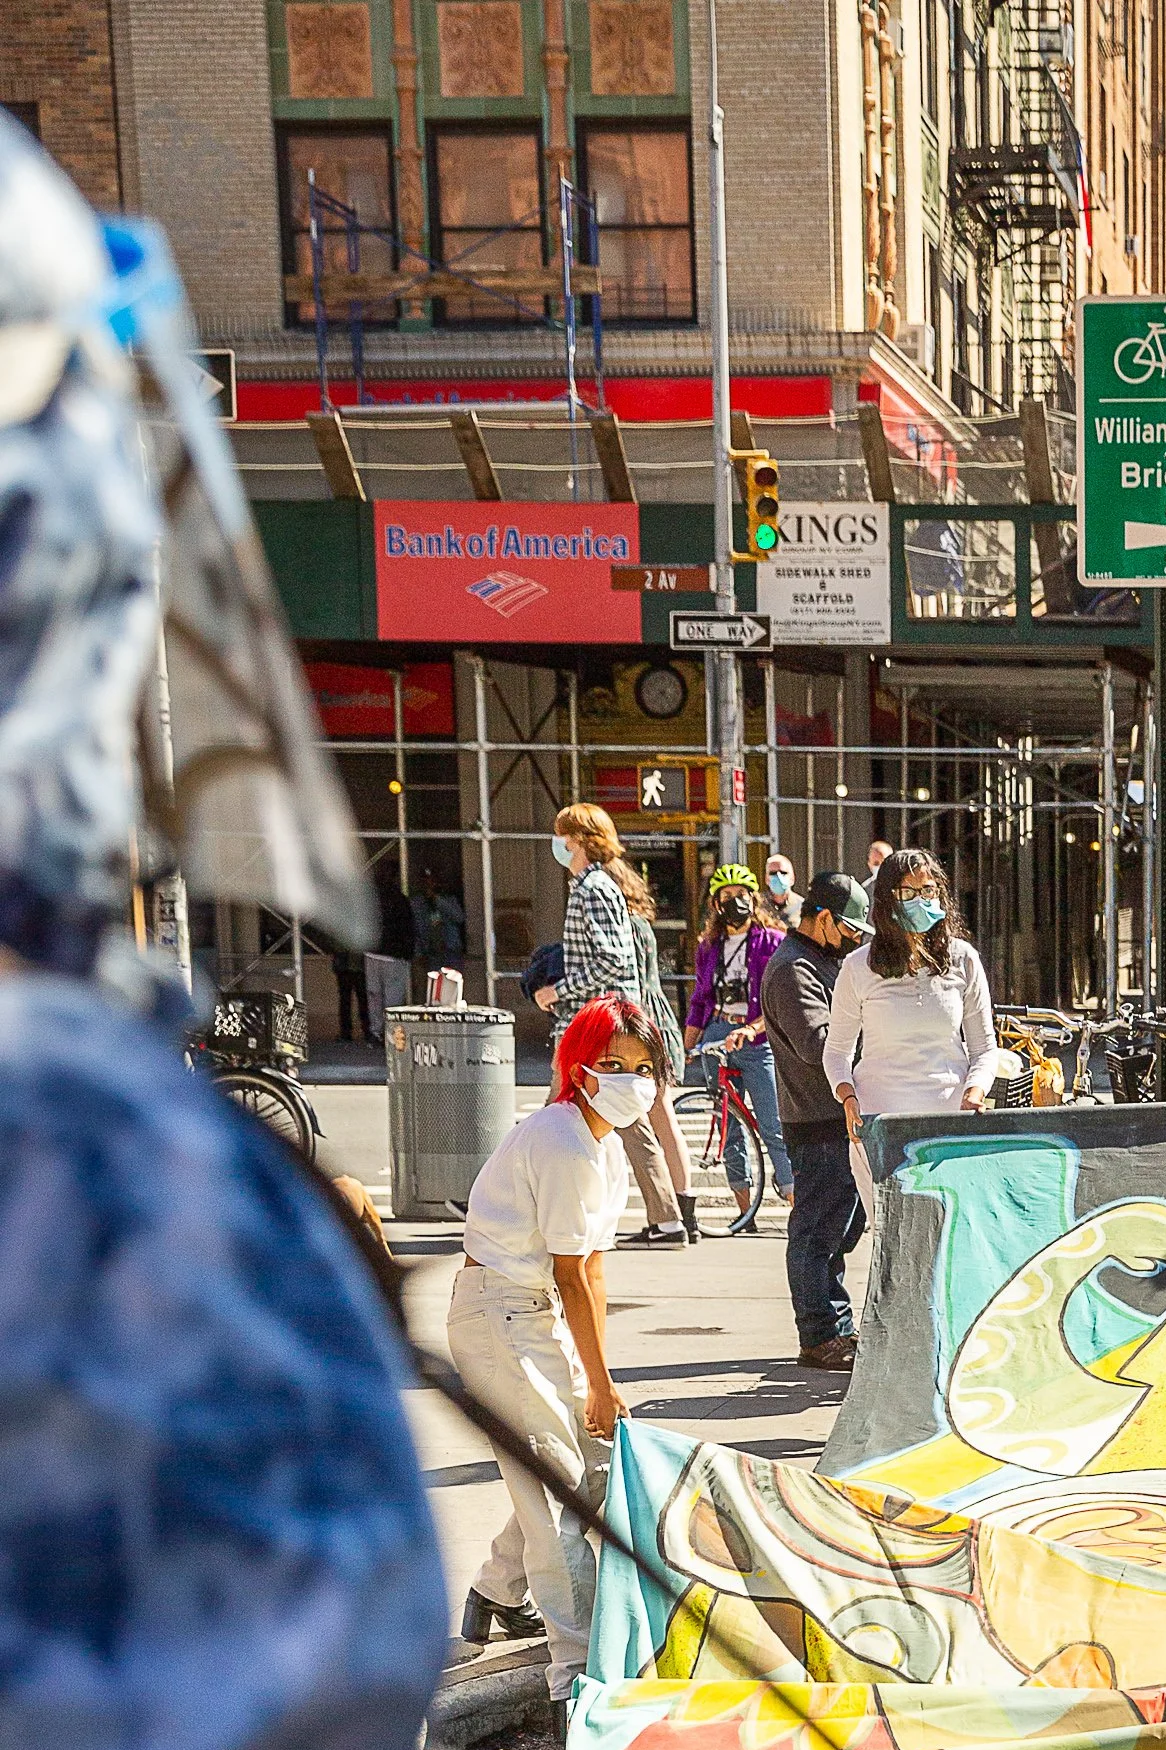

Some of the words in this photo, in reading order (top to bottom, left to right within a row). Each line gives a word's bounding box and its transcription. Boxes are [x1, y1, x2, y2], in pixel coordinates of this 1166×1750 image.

[385, 524, 465, 558] Bank
[466, 524, 499, 558] of
[501, 526, 629, 559] America
[644, 570, 654, 590] 2
[658, 570, 677, 590] Av
[775, 567, 836, 579] SIDEWALK
[839, 567, 872, 579] SHED
[792, 593, 854, 605] SCAFFOLD
[686, 622, 714, 639] ONE
[726, 623, 757, 640] WAY
